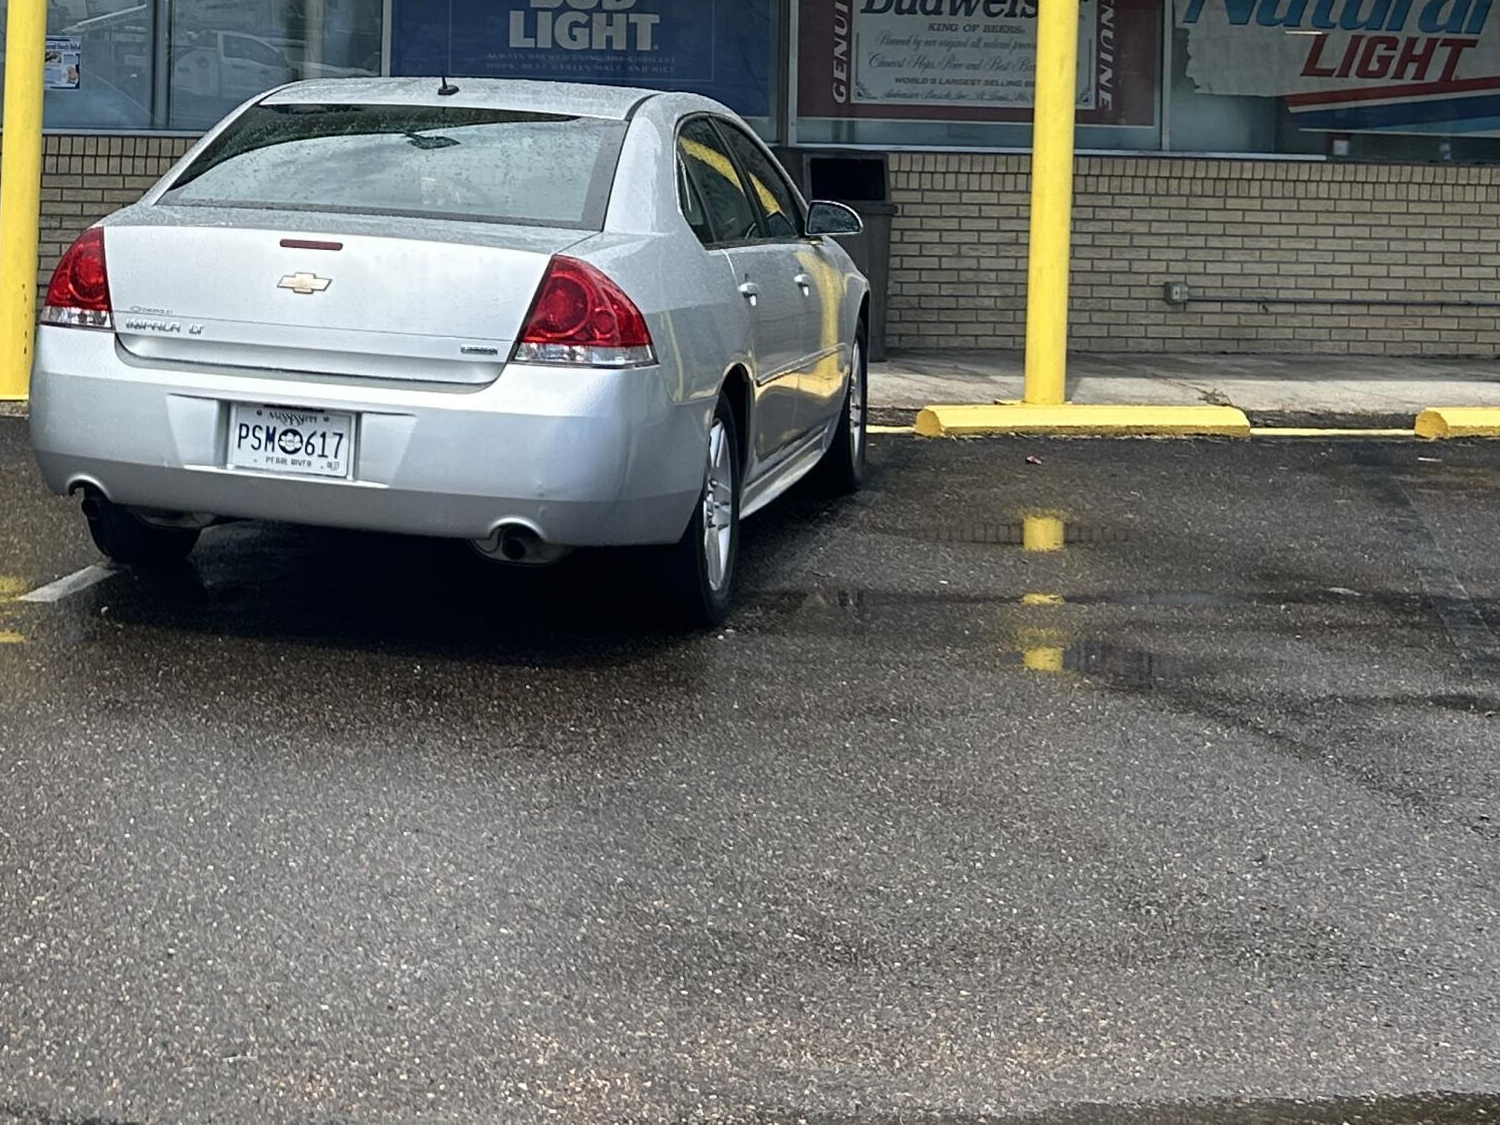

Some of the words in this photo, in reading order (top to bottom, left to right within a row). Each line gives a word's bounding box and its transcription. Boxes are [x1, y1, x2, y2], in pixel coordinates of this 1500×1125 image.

[508, 10, 660, 51] LIGHT
[927, 22, 958, 33] KING
[962, 23, 980, 33] OF
[1299, 34, 1478, 82] LIGHT
[894, 77, 937, 85] WORLD'S
[938, 78, 981, 86] LARGEST
[983, 79, 1022, 87] SELLING
[125, 317, 181, 333] IMPALA
[189, 322, 204, 335] LT
[237, 423, 276, 453] PSM
[304, 430, 344, 459] 617
[265, 456, 287, 465] PEARL
[290, 457, 312, 467] RIVER
